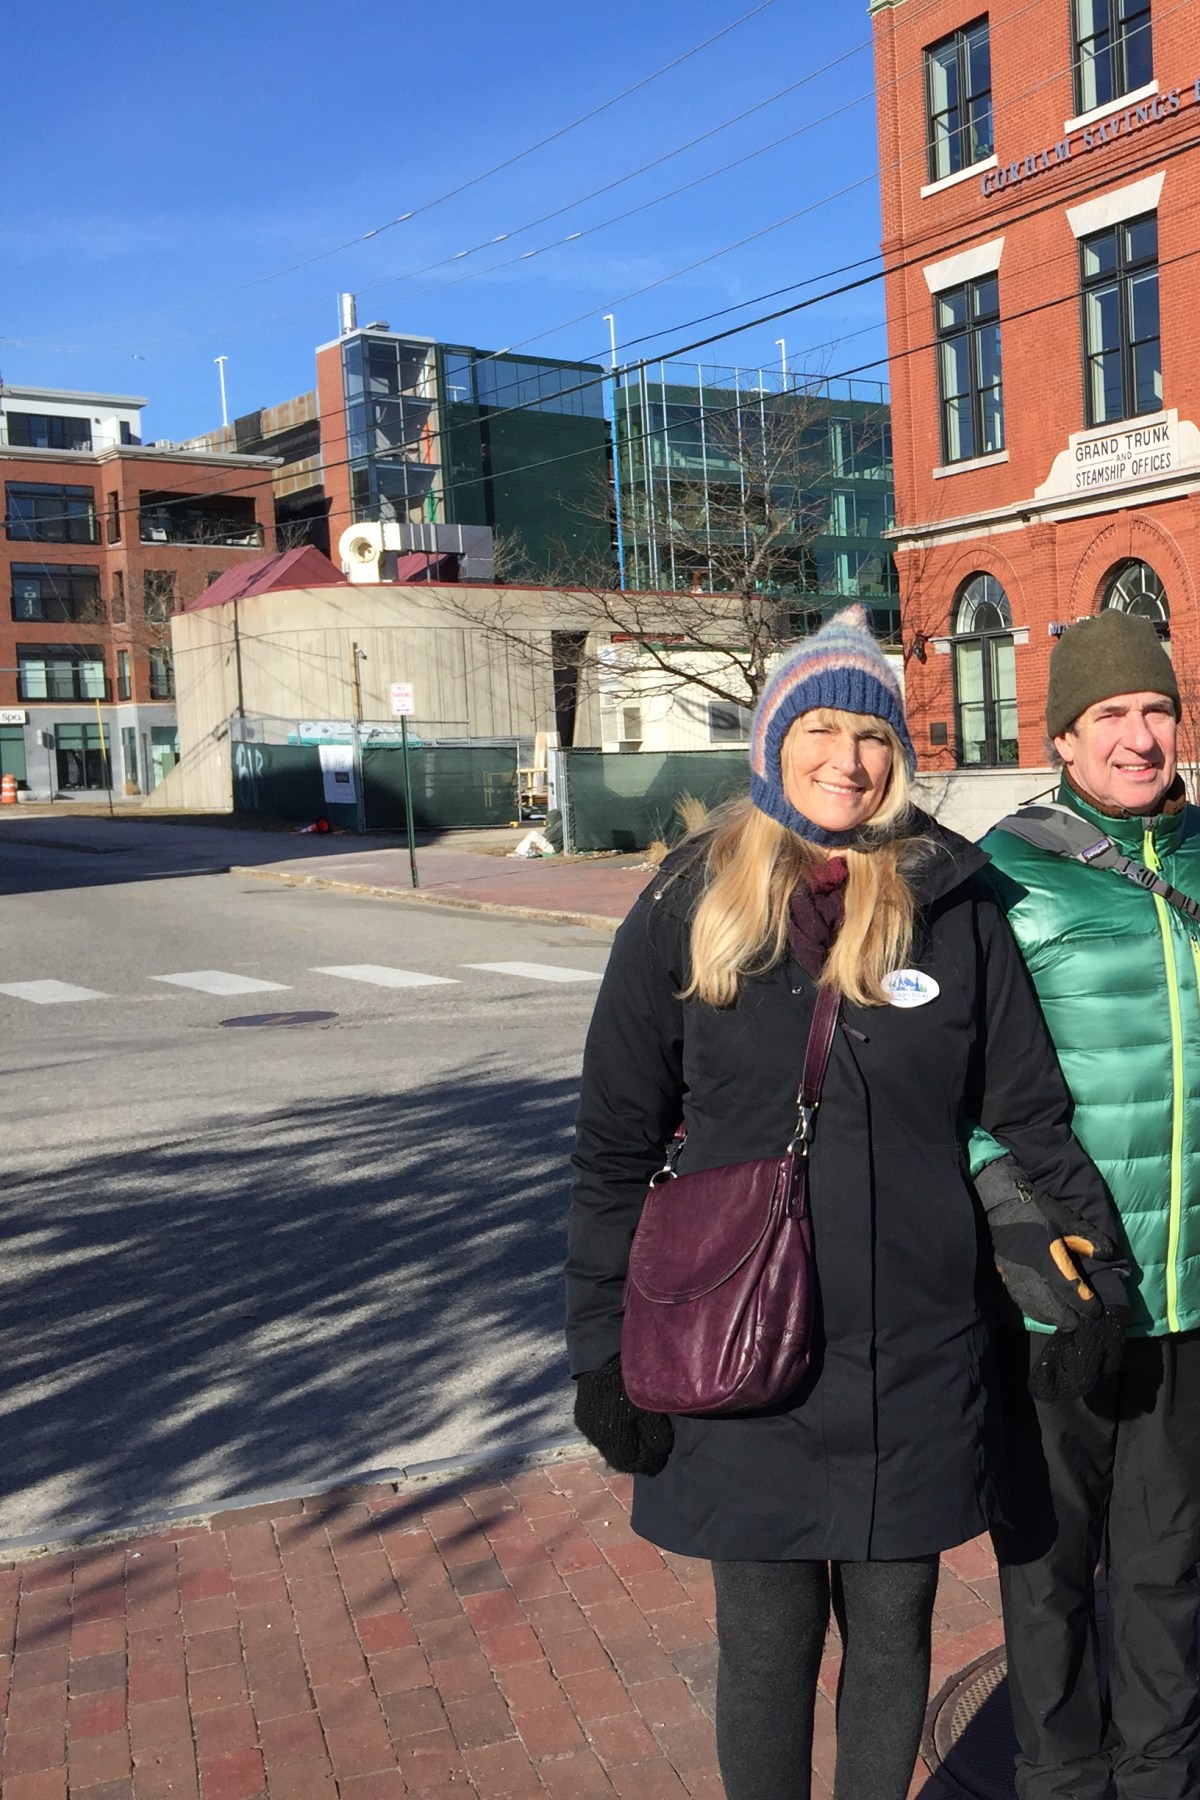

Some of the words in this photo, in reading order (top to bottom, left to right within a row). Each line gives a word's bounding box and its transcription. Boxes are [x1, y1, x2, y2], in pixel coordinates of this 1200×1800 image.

[981, 139, 1071, 195] GORHAM
[1083, 89, 1180, 150] SAVINGS
[1075, 438, 1119, 462] GRAND
[1125, 425, 1170, 449] TRUNK
[1115, 451, 1132, 462] AND
[1075, 462, 1126, 488] STEAMSHIP
[1132, 453, 1171, 476] OFFICES
